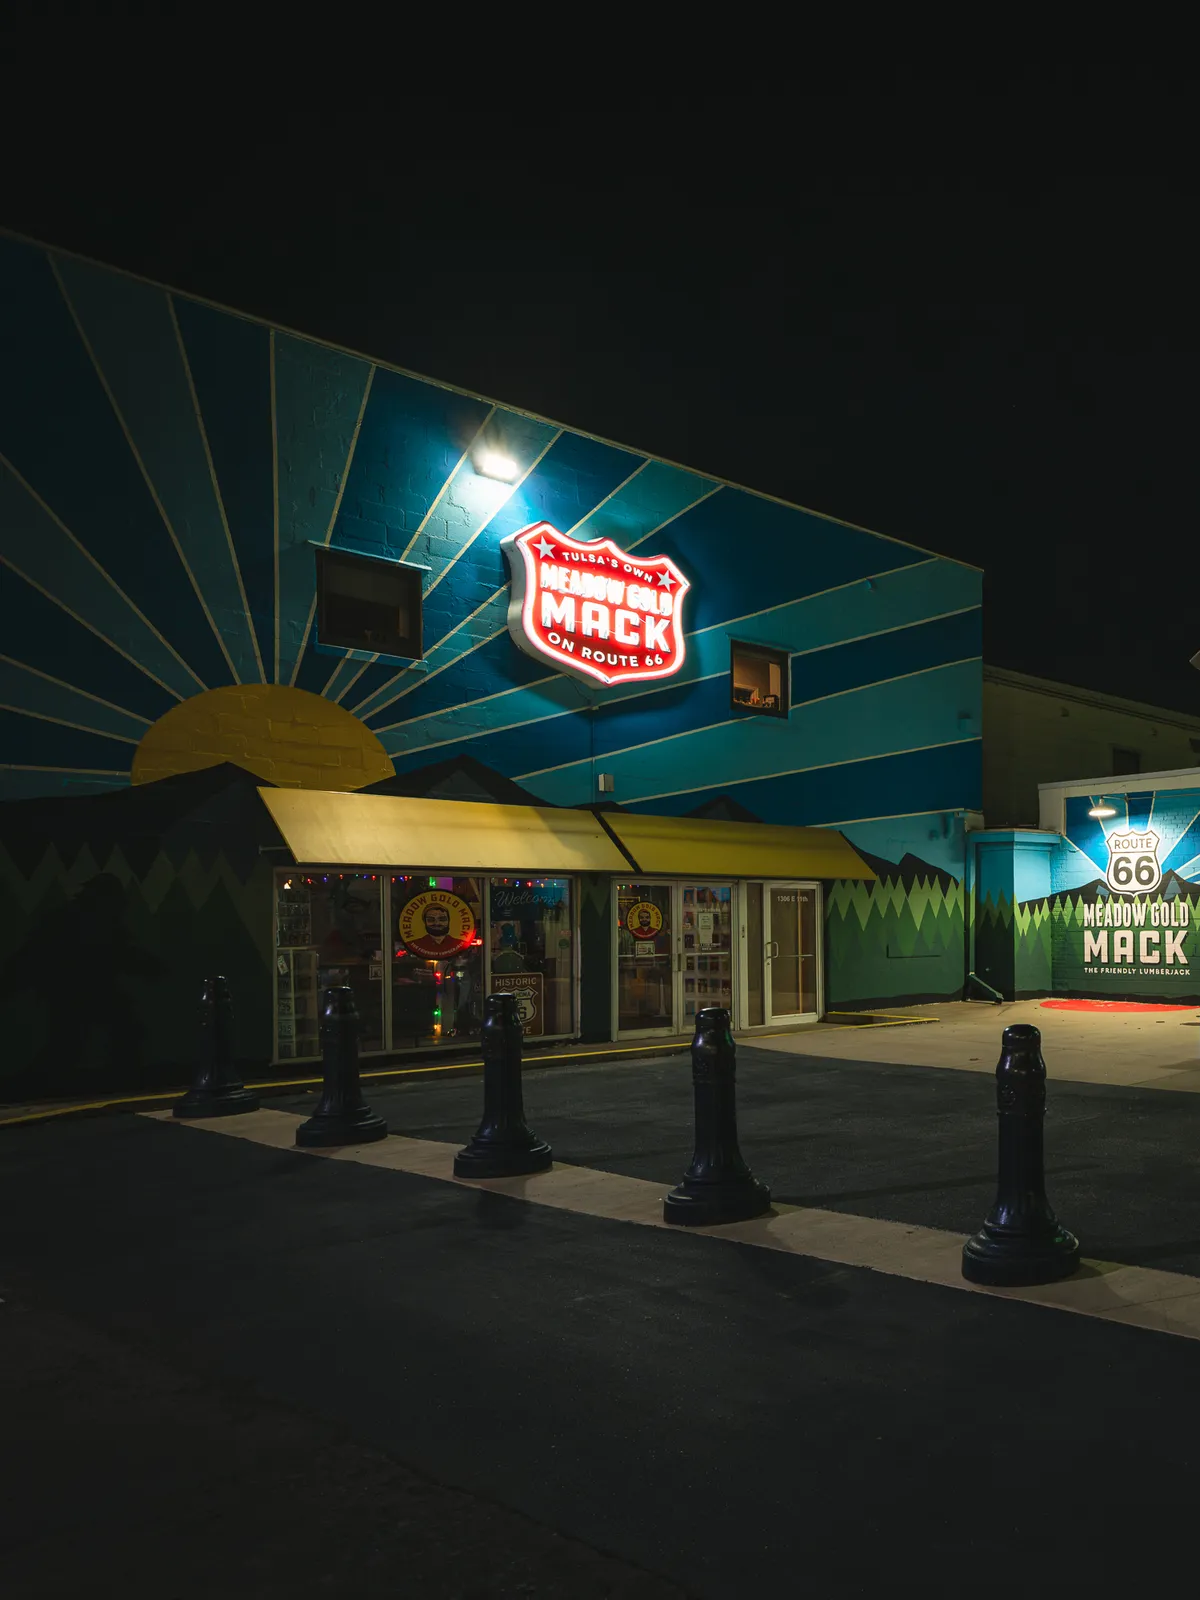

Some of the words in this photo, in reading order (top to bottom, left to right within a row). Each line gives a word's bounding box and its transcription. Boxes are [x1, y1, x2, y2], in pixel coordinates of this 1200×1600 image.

[562, 552, 619, 568] TULSA'S
[623, 563, 653, 583] OWN
[540, 562, 625, 605] MEADOW
[626, 584, 673, 616] GOLD
[541, 591, 673, 653] MACK
[547, 632, 574, 653] ON
[581, 648, 639, 667] ROUTE
[644, 653, 664, 667] 66
[1114, 838, 1153, 850] ROUTE
[1113, 855, 1155, 886] 66
[402, 896, 428, 939] MEADOW
[430, 893, 460, 909] GOLD
[458, 908, 471, 939] MACK
[1083, 902, 1149, 927] MEADOW
[1150, 902, 1190, 928] GOLD
[1083, 929, 1189, 965] MACK
[495, 977, 538, 988] HISTORIC
[1100, 967, 1137, 975] FRIENDLY
[1139, 968, 1191, 976] LUMBERJACK
